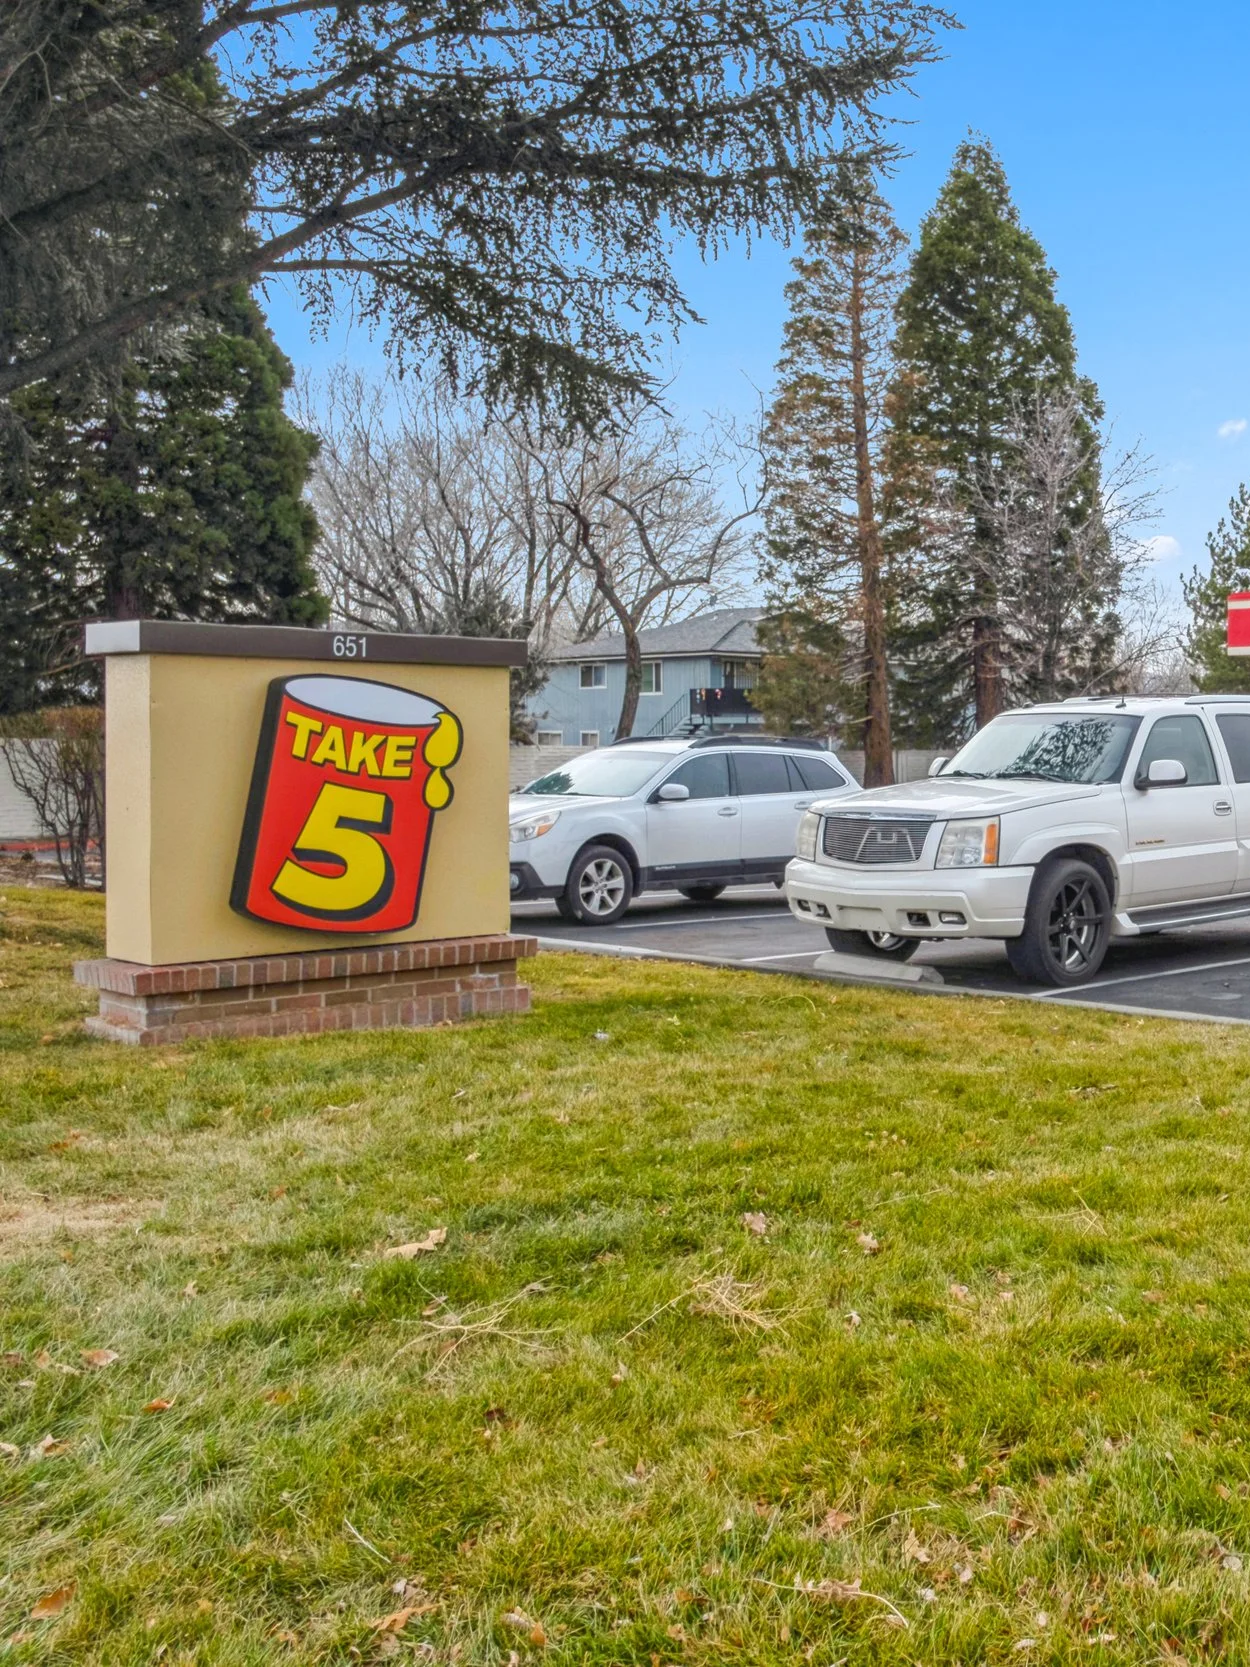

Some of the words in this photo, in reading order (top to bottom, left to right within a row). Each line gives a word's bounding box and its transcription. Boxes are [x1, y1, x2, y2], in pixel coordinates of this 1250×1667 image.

[333, 636, 367, 658] 651
[285, 711, 418, 780] TAKE
[271, 781, 395, 922] 5
